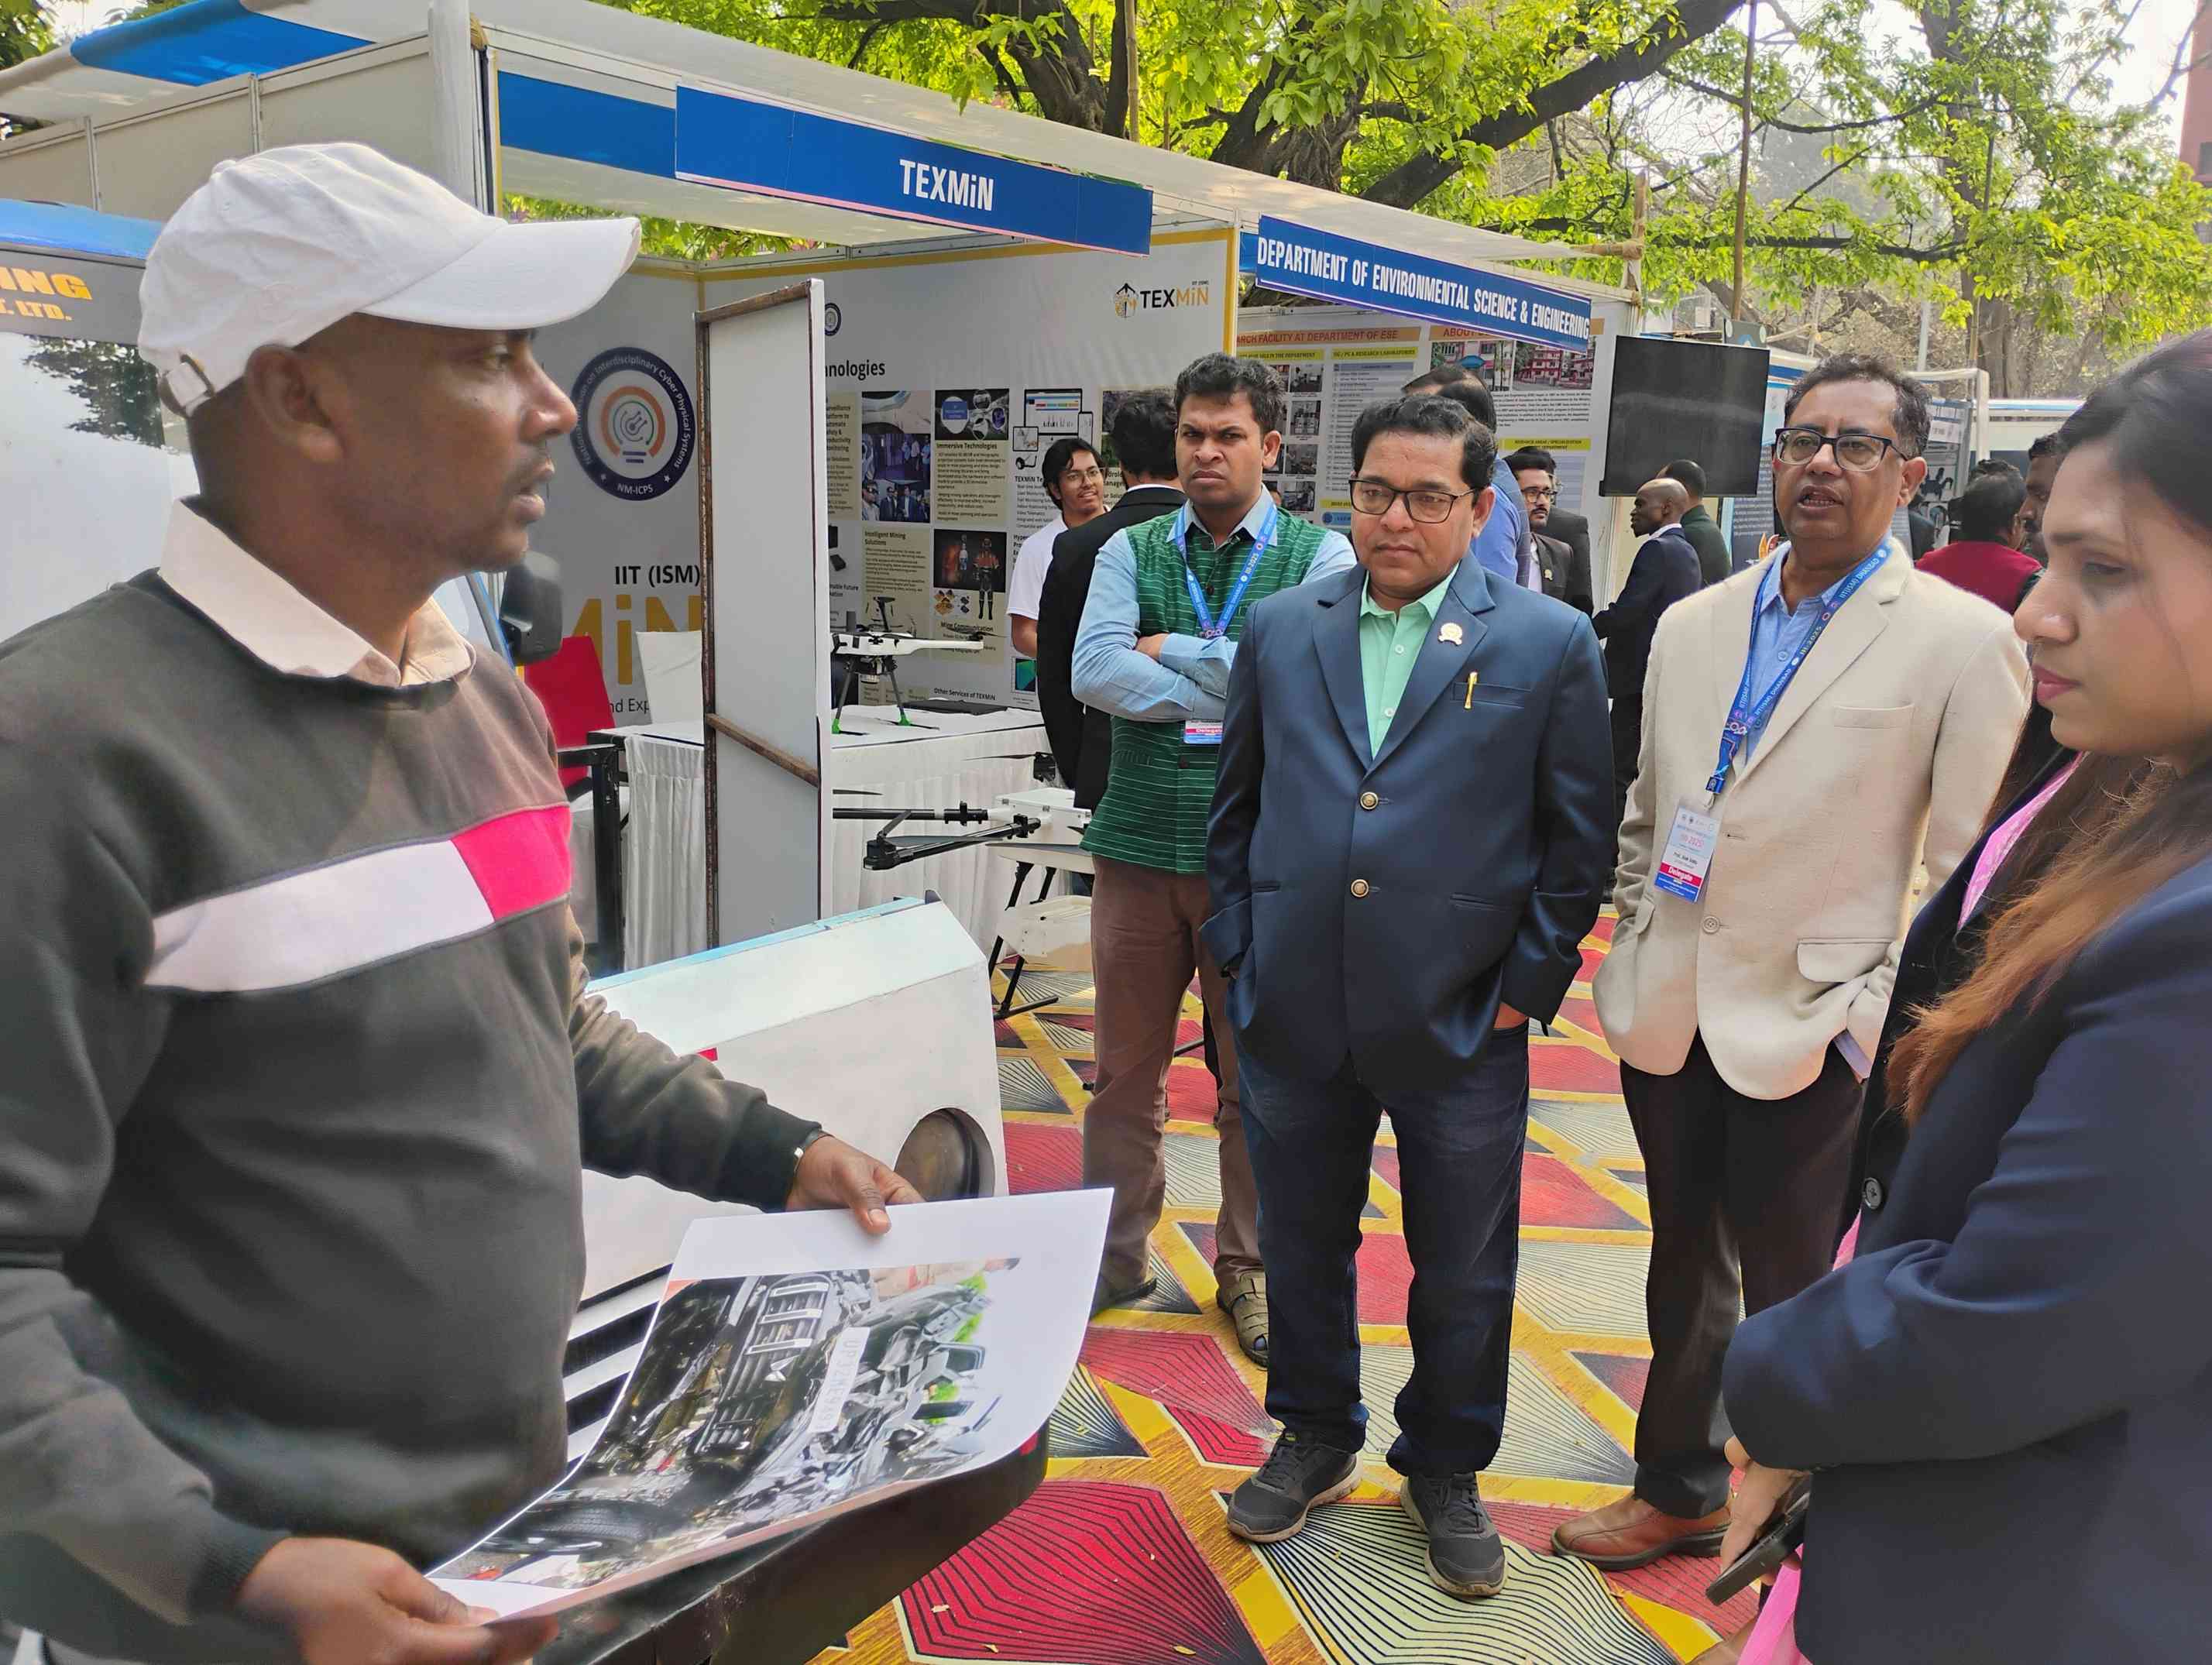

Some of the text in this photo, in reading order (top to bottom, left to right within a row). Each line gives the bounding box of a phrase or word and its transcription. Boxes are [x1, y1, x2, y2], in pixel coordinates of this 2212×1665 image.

[899, 158, 994, 212] TEXMiN
[1140, 287, 1208, 308] TEXMiN
[1257, 235, 1591, 341] DEPARTMENT OF ENVIRONMENTAL SCIENCE & ENGINEERING
[15, 300, 72, 321] LTD.
[1258, 333, 1294, 344] FACILITY
[1307, 331, 1364, 342] DEPARTMENT
[1366, 331, 1379, 340] OF
[659, 370, 678, 393] Cyber
[675, 431, 691, 469] Systems
[617, 482, 654, 496] NM-ICPS
[615, 565, 700, 588] IIT (ISM)
[949, 689, 969, 698] Services
